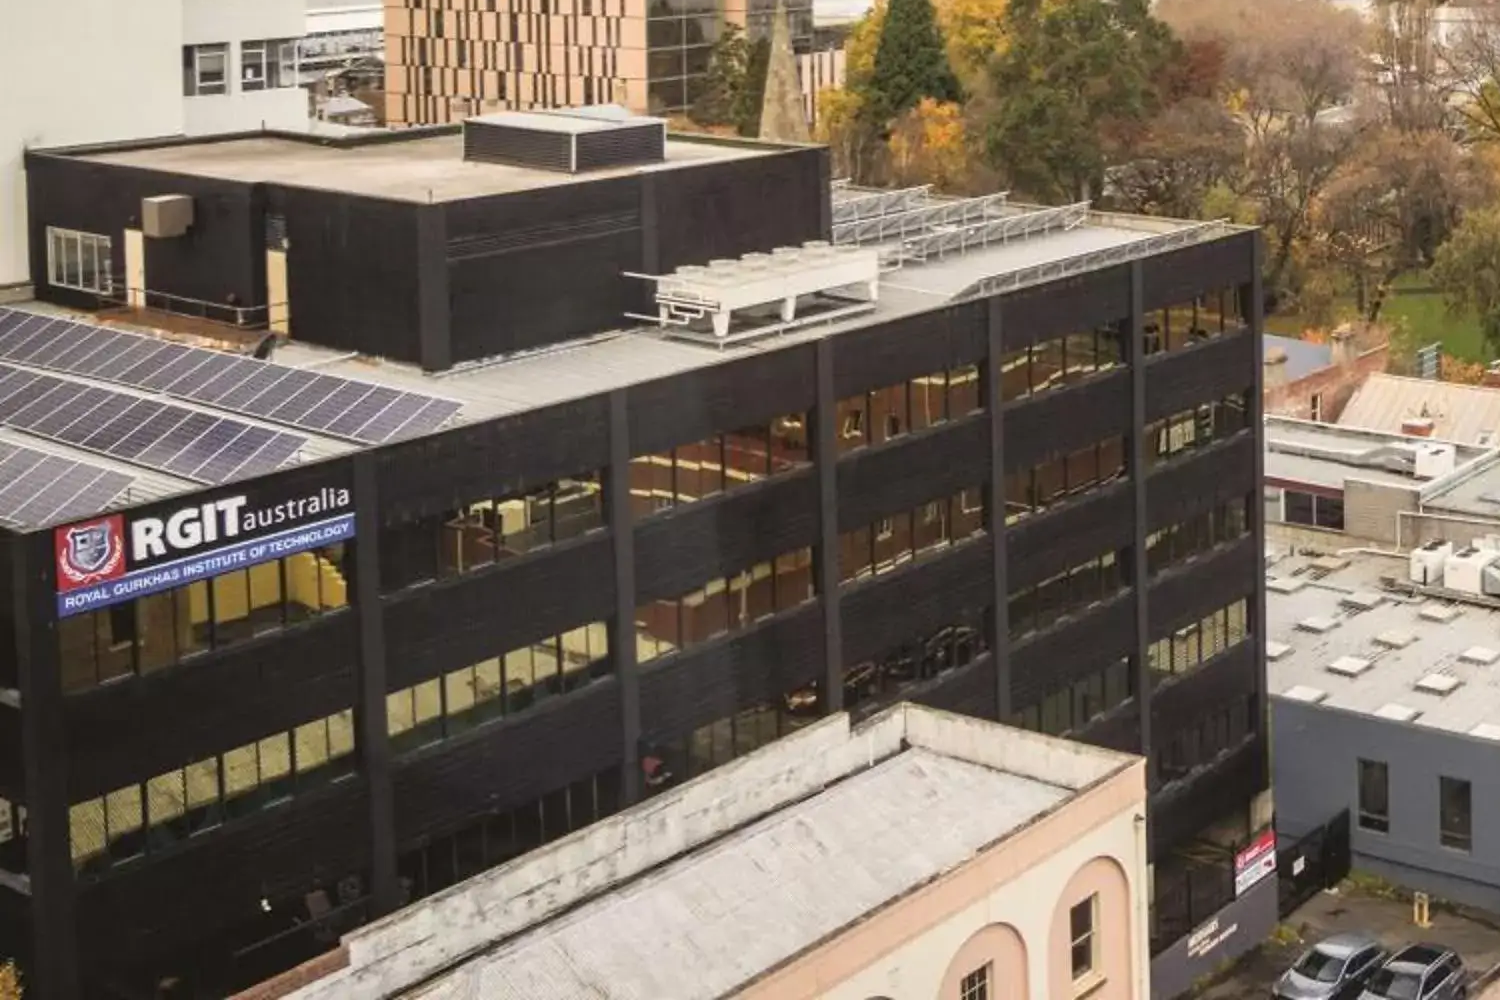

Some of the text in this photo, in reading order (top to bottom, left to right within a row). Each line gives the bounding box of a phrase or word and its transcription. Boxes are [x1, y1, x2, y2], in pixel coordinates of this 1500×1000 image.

[132, 487, 350, 561] RGIT australia
[65, 522, 349, 608] ROYAL GURKHAS INSTITUTE OF TECHNOLOGY
